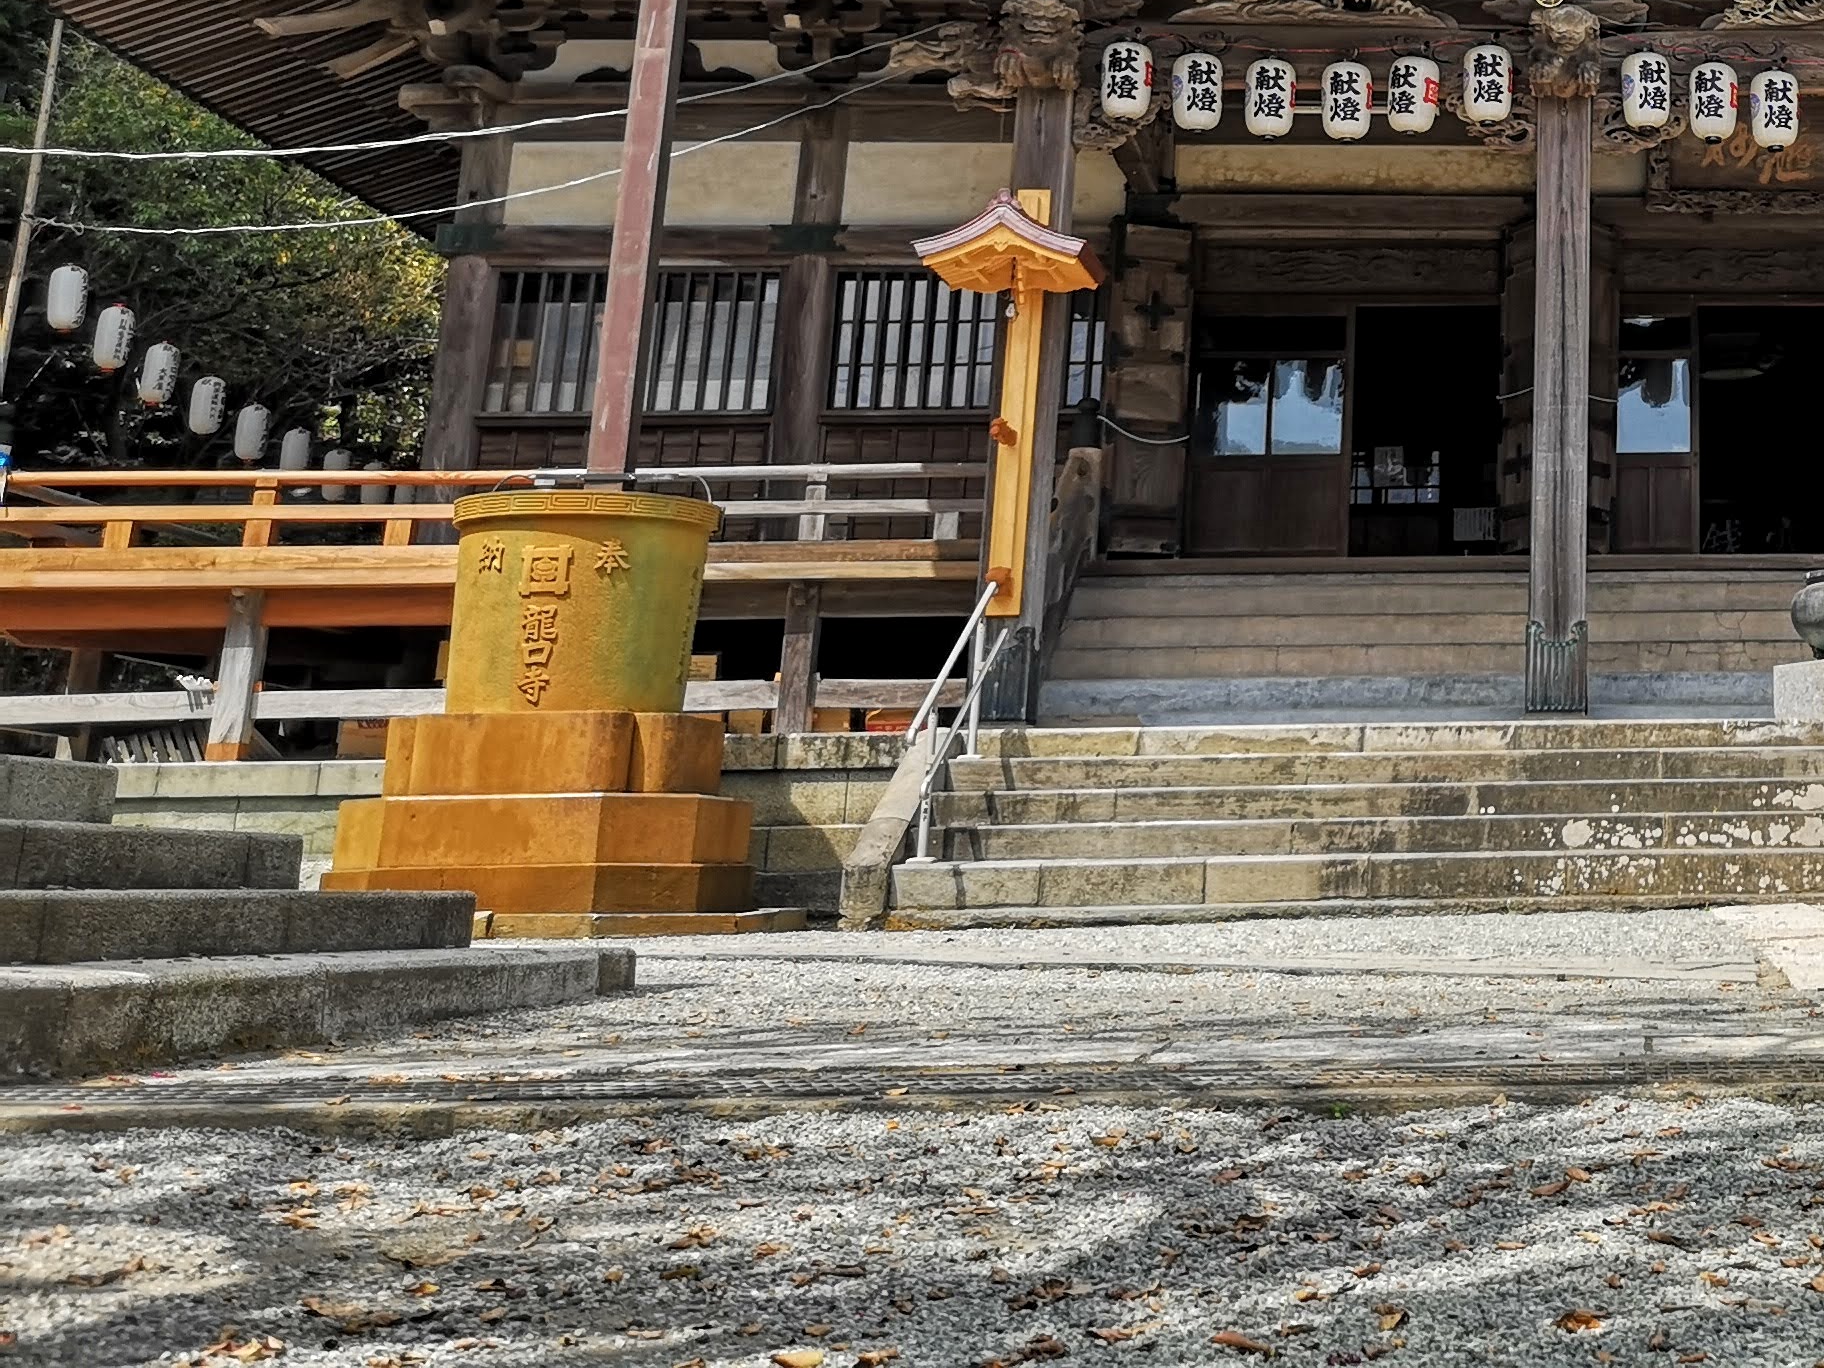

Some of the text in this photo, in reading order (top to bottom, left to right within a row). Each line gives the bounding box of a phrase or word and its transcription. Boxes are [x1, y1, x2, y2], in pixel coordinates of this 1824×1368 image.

[1107, 48, 1139, 100] 献燈
[1187, 60, 1218, 113] 献燈
[1254, 66, 1286, 119] 献燈
[1330, 71, 1361, 122] 献燈
[1389, 65, 1417, 115] 献燈
[1474, 53, 1504, 103] 献燈
[1639, 60, 1667, 111] 献燈
[1695, 69, 1724, 119] 献燈
[1765, 79, 1793, 130] 献燈
[478, 536, 632, 574] 奉 納
[517, 605, 558, 707] 龍口寺
